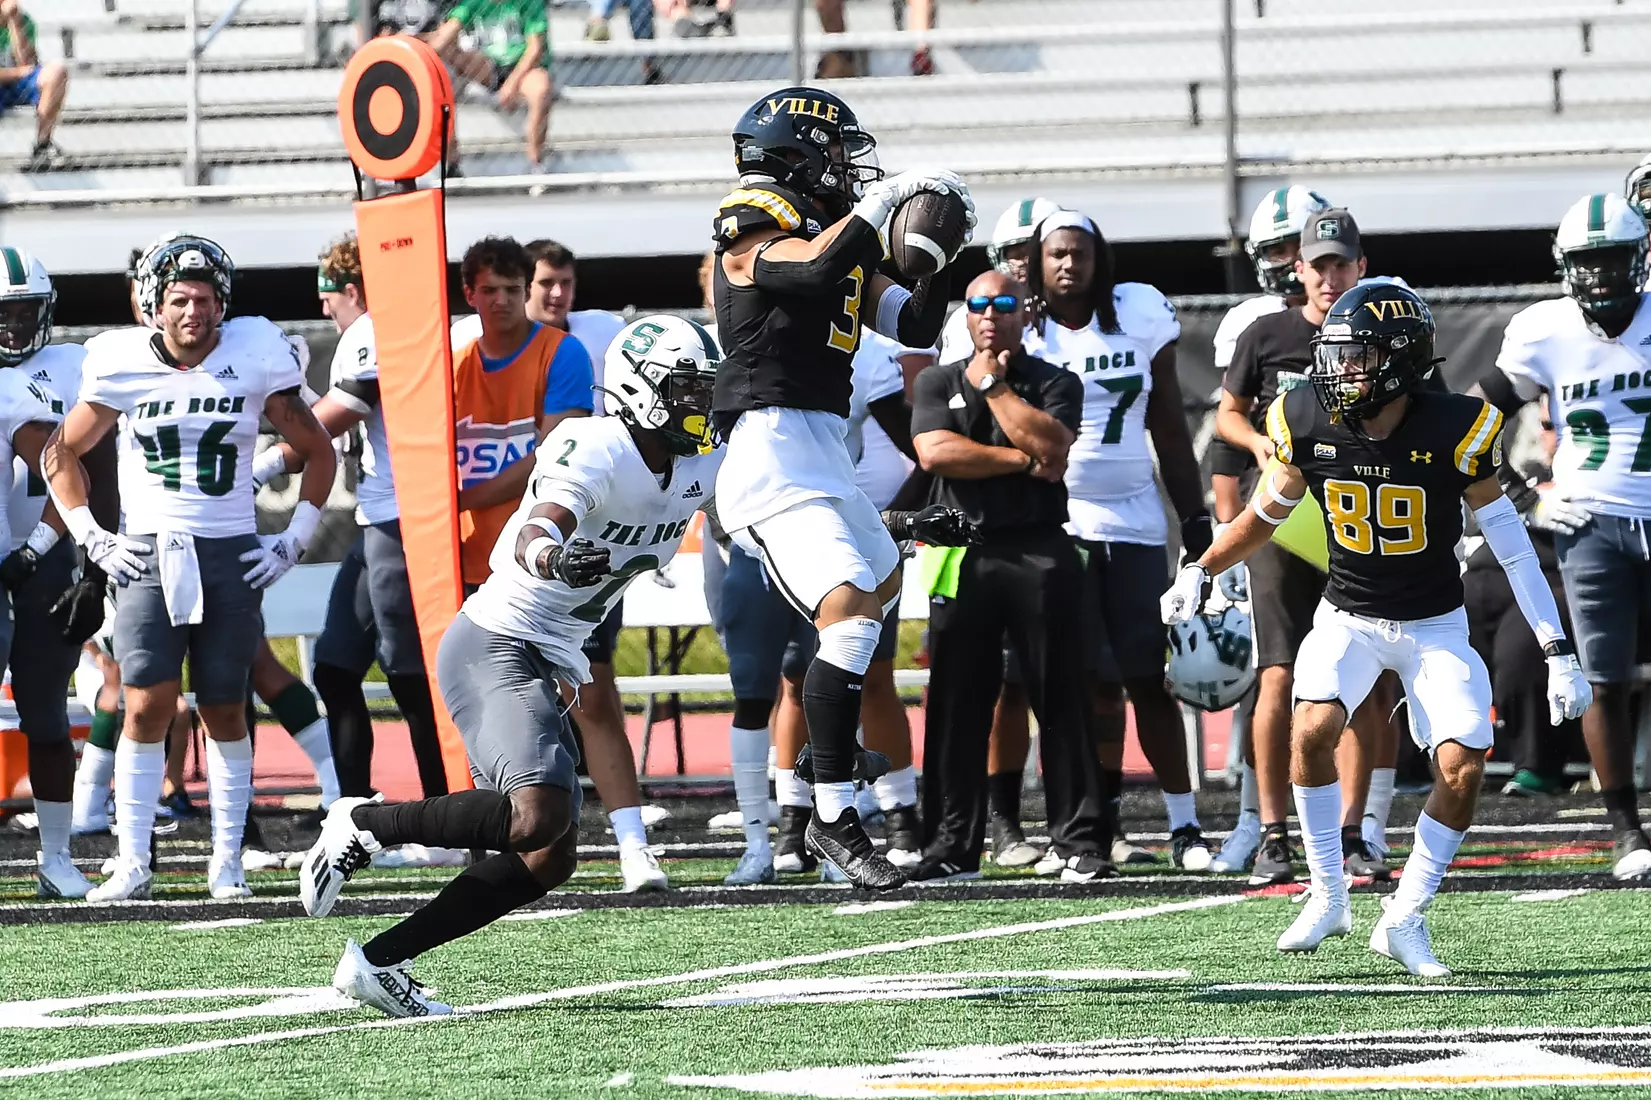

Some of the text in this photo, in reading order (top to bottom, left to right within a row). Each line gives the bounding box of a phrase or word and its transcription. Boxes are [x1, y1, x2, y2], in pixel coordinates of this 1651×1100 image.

[767, 97, 839, 125] VILLE
[826, 264, 865, 354] 3
[1364, 300, 1429, 323] VILLE
[620, 321, 669, 357] S
[1561, 378, 1601, 402] THE
[138, 396, 246, 420] THE ROCK
[1093, 373, 1144, 445] 7
[133, 420, 239, 497] 46
[555, 438, 577, 467] 2
[1352, 464, 1390, 480] VILLE
[1323, 478, 1429, 556] 89
[599, 519, 648, 546] THE
